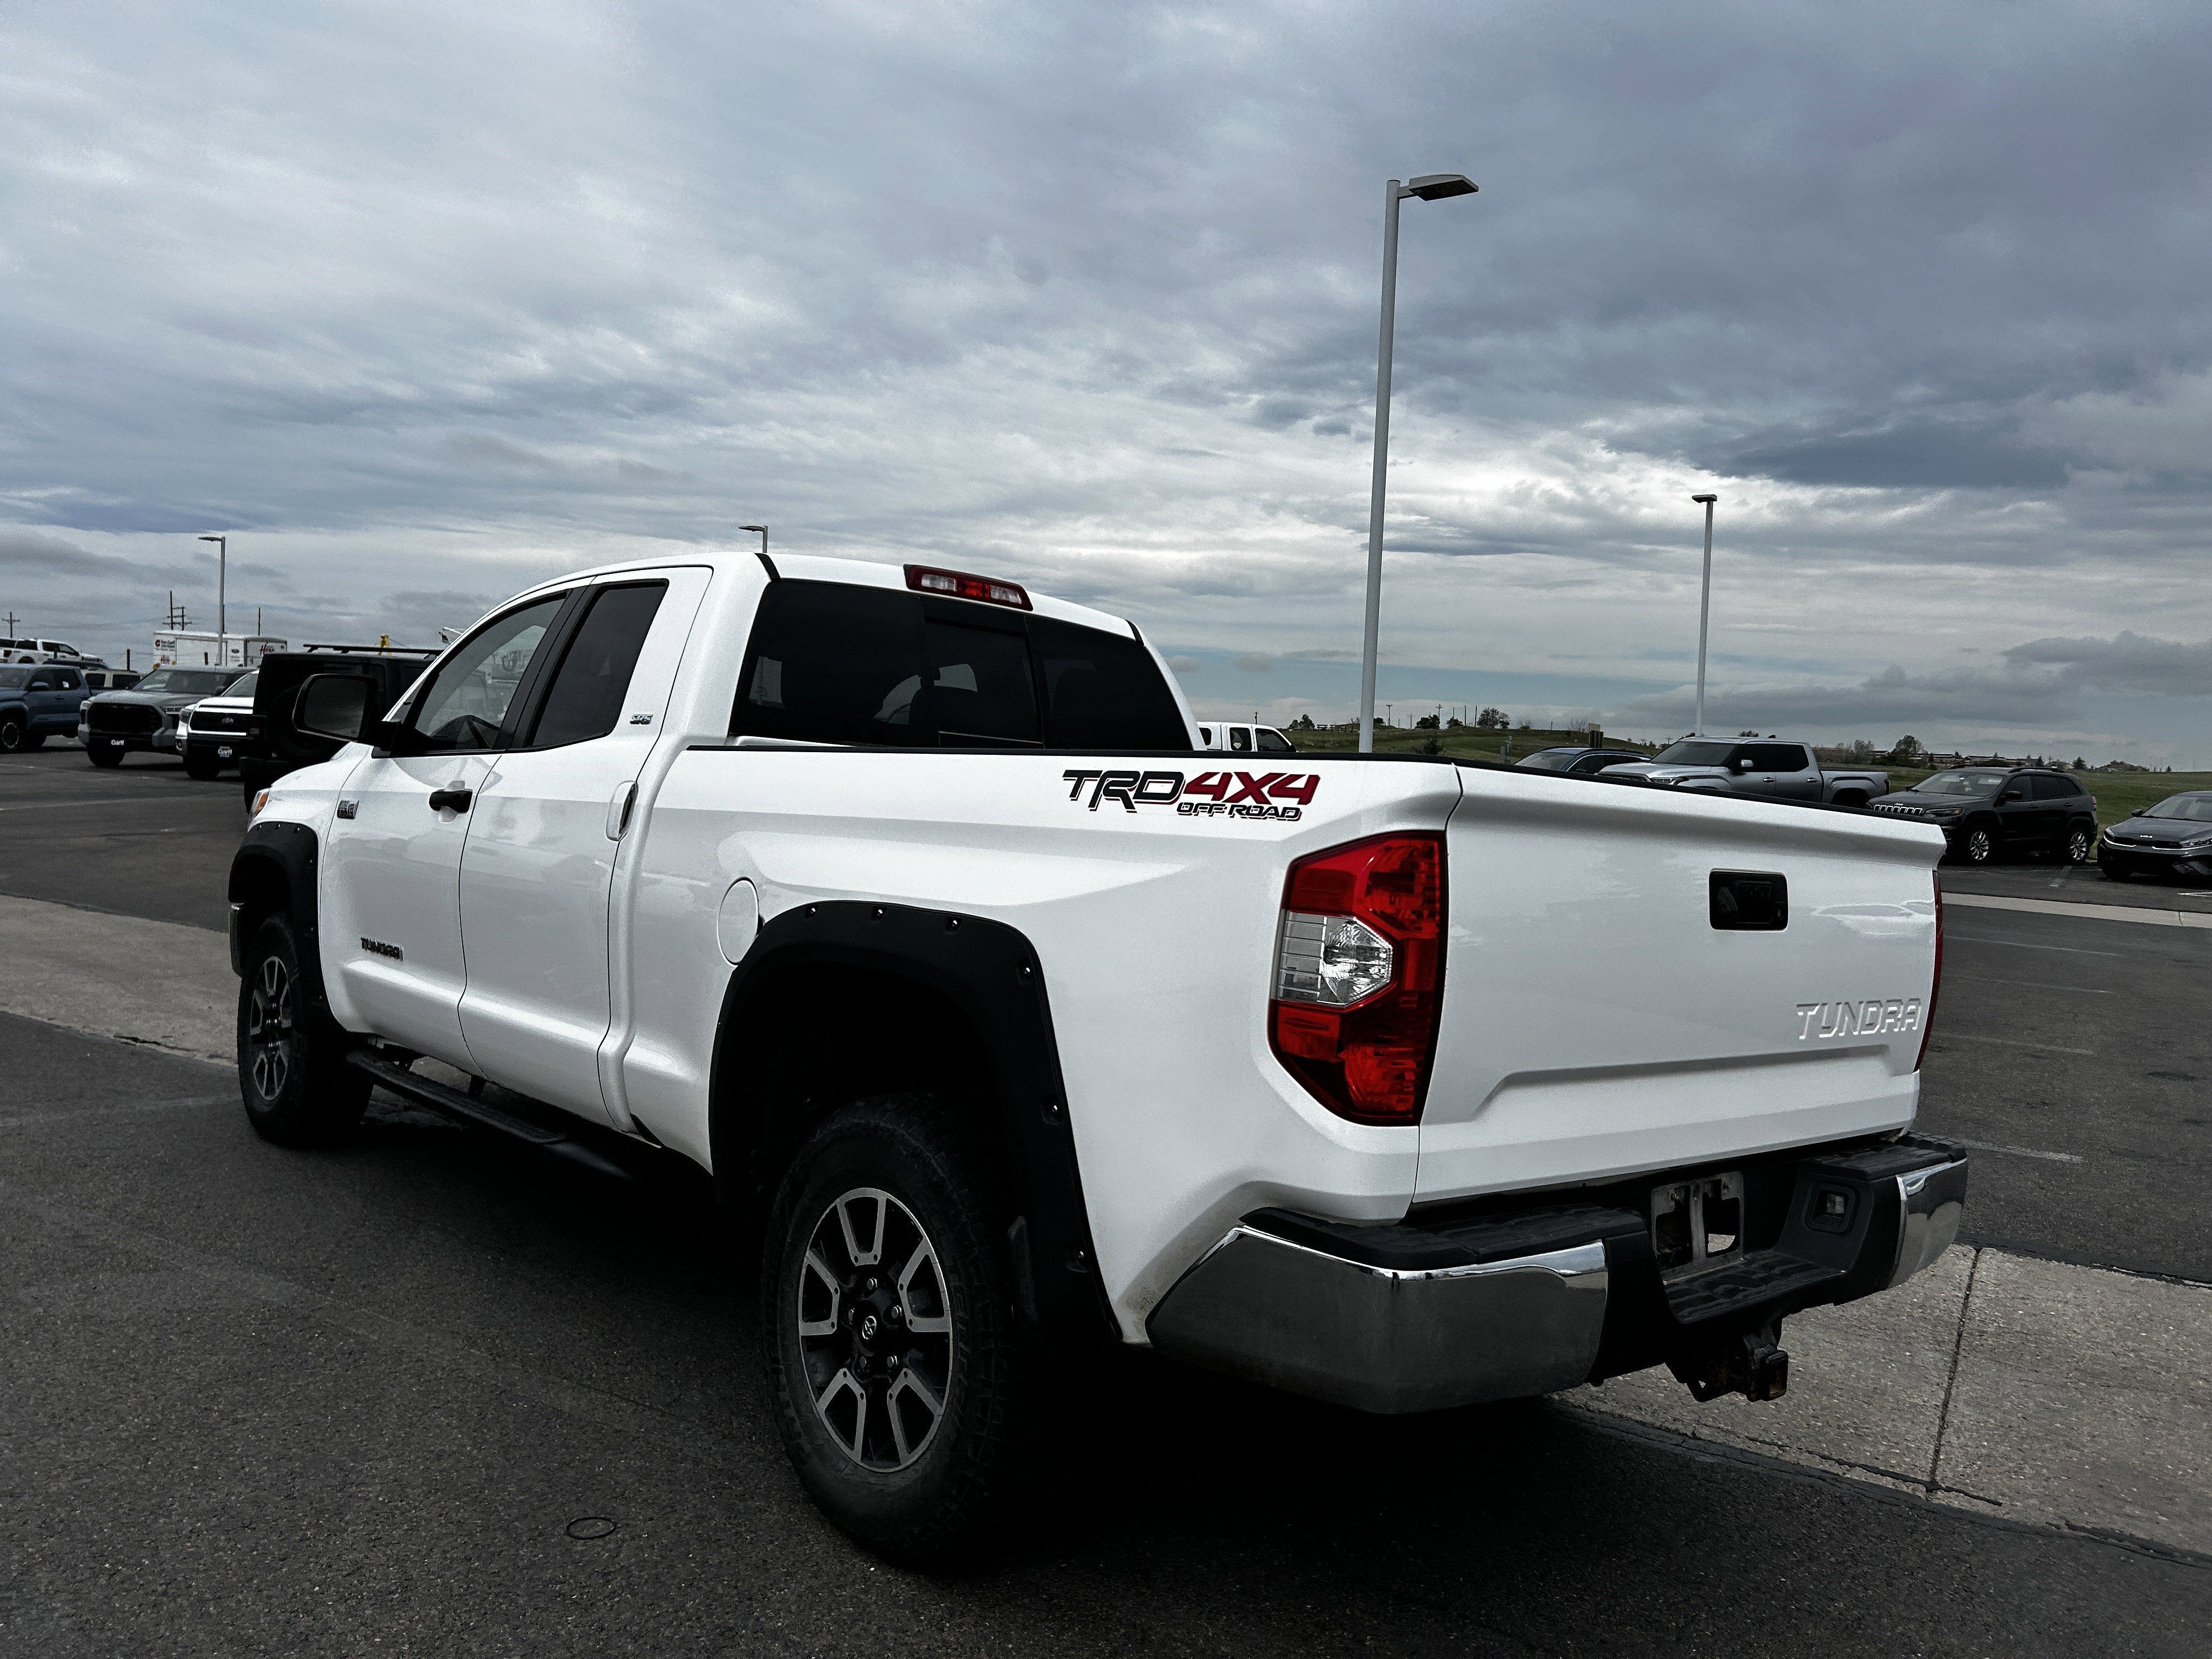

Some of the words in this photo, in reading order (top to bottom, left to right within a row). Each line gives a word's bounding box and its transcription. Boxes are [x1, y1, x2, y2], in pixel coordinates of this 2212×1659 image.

[1063, 770, 1185, 814] TRD
[1177, 802, 1227, 817] OFF
[1228, 805, 1302, 821] ROAD
[360, 936, 403, 961] TUNDRA
[1796, 998, 1921, 1040] TUNDRA
